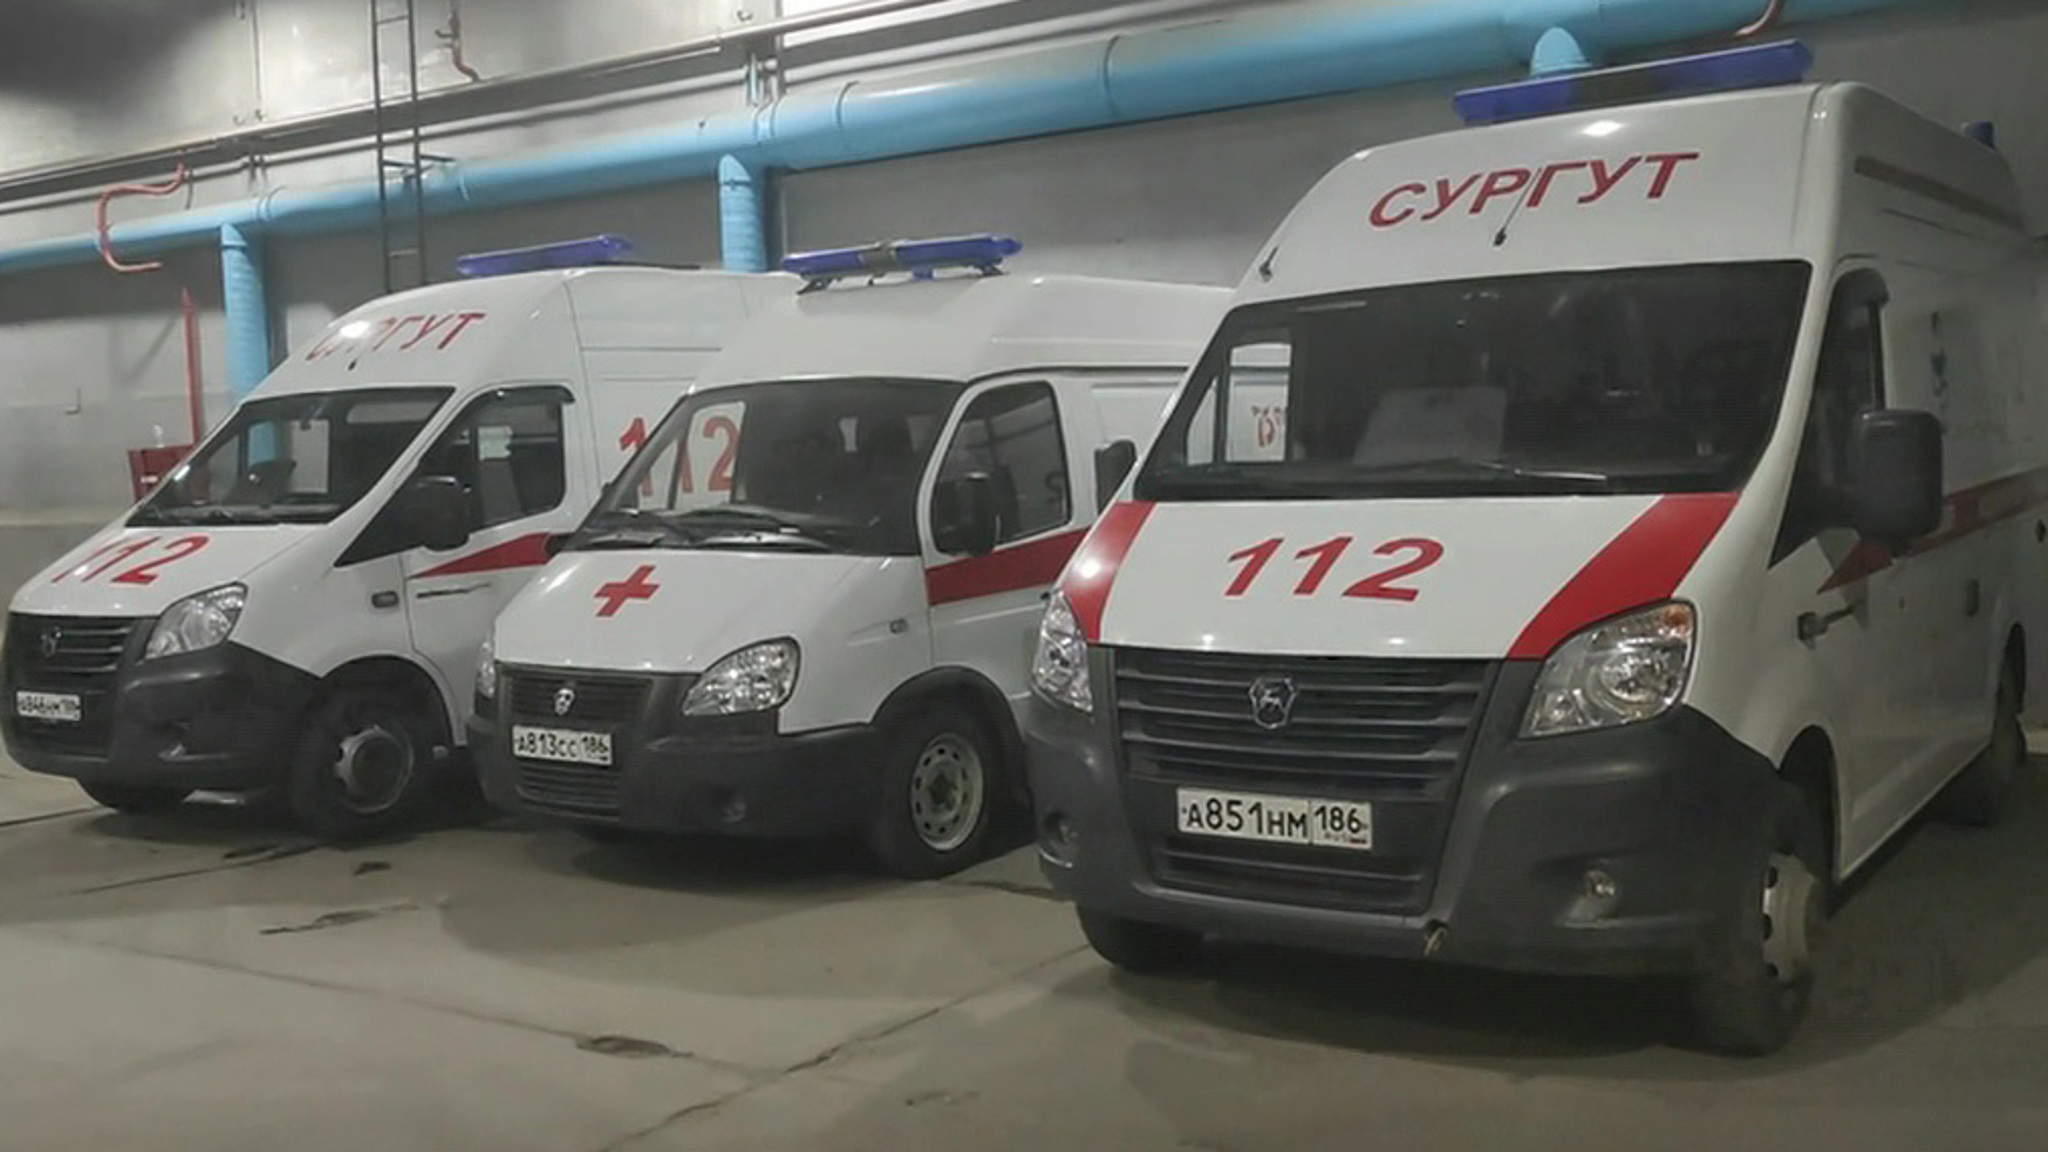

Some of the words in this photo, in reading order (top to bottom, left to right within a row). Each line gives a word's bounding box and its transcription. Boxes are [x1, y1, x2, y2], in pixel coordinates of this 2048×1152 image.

[1369, 152, 1700, 227] СУРГУТ
[51, 536, 209, 586] 112
[1224, 536, 1444, 602] 112
[1186, 797, 1309, 839] А851НМ
[1314, 805, 1362, 834] 186
